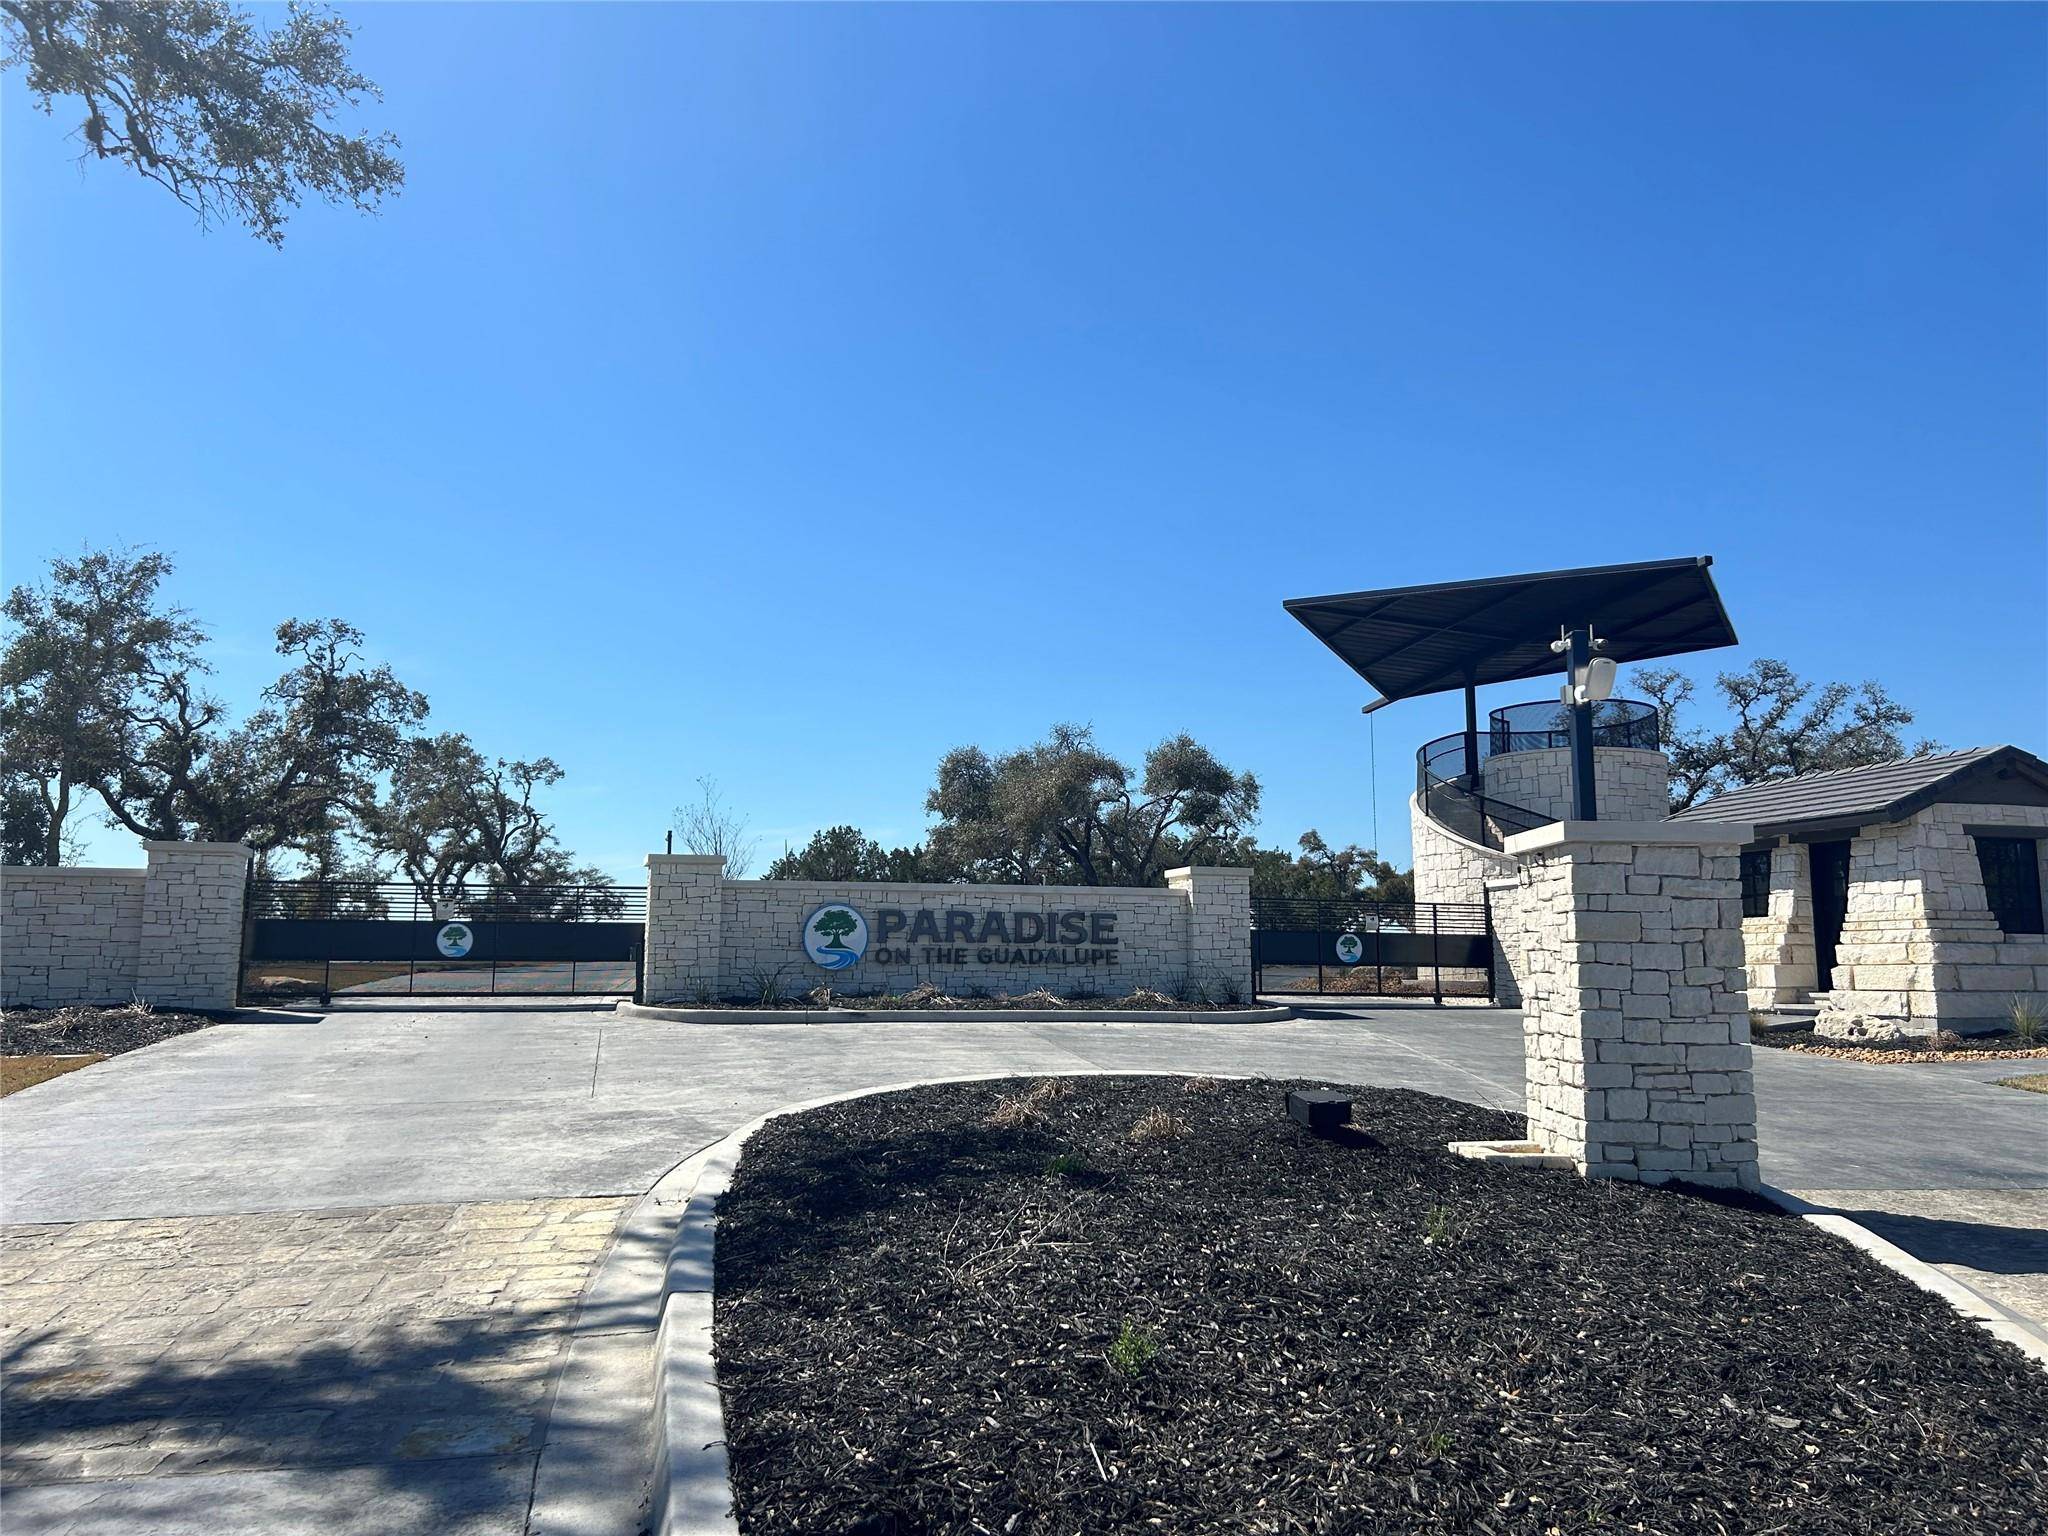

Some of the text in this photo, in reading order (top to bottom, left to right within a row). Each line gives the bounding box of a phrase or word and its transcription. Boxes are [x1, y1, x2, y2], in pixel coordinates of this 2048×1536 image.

[876, 910, 1118, 944] PARADISE
[875, 947, 1118, 966] ON THE GUADALUPE
